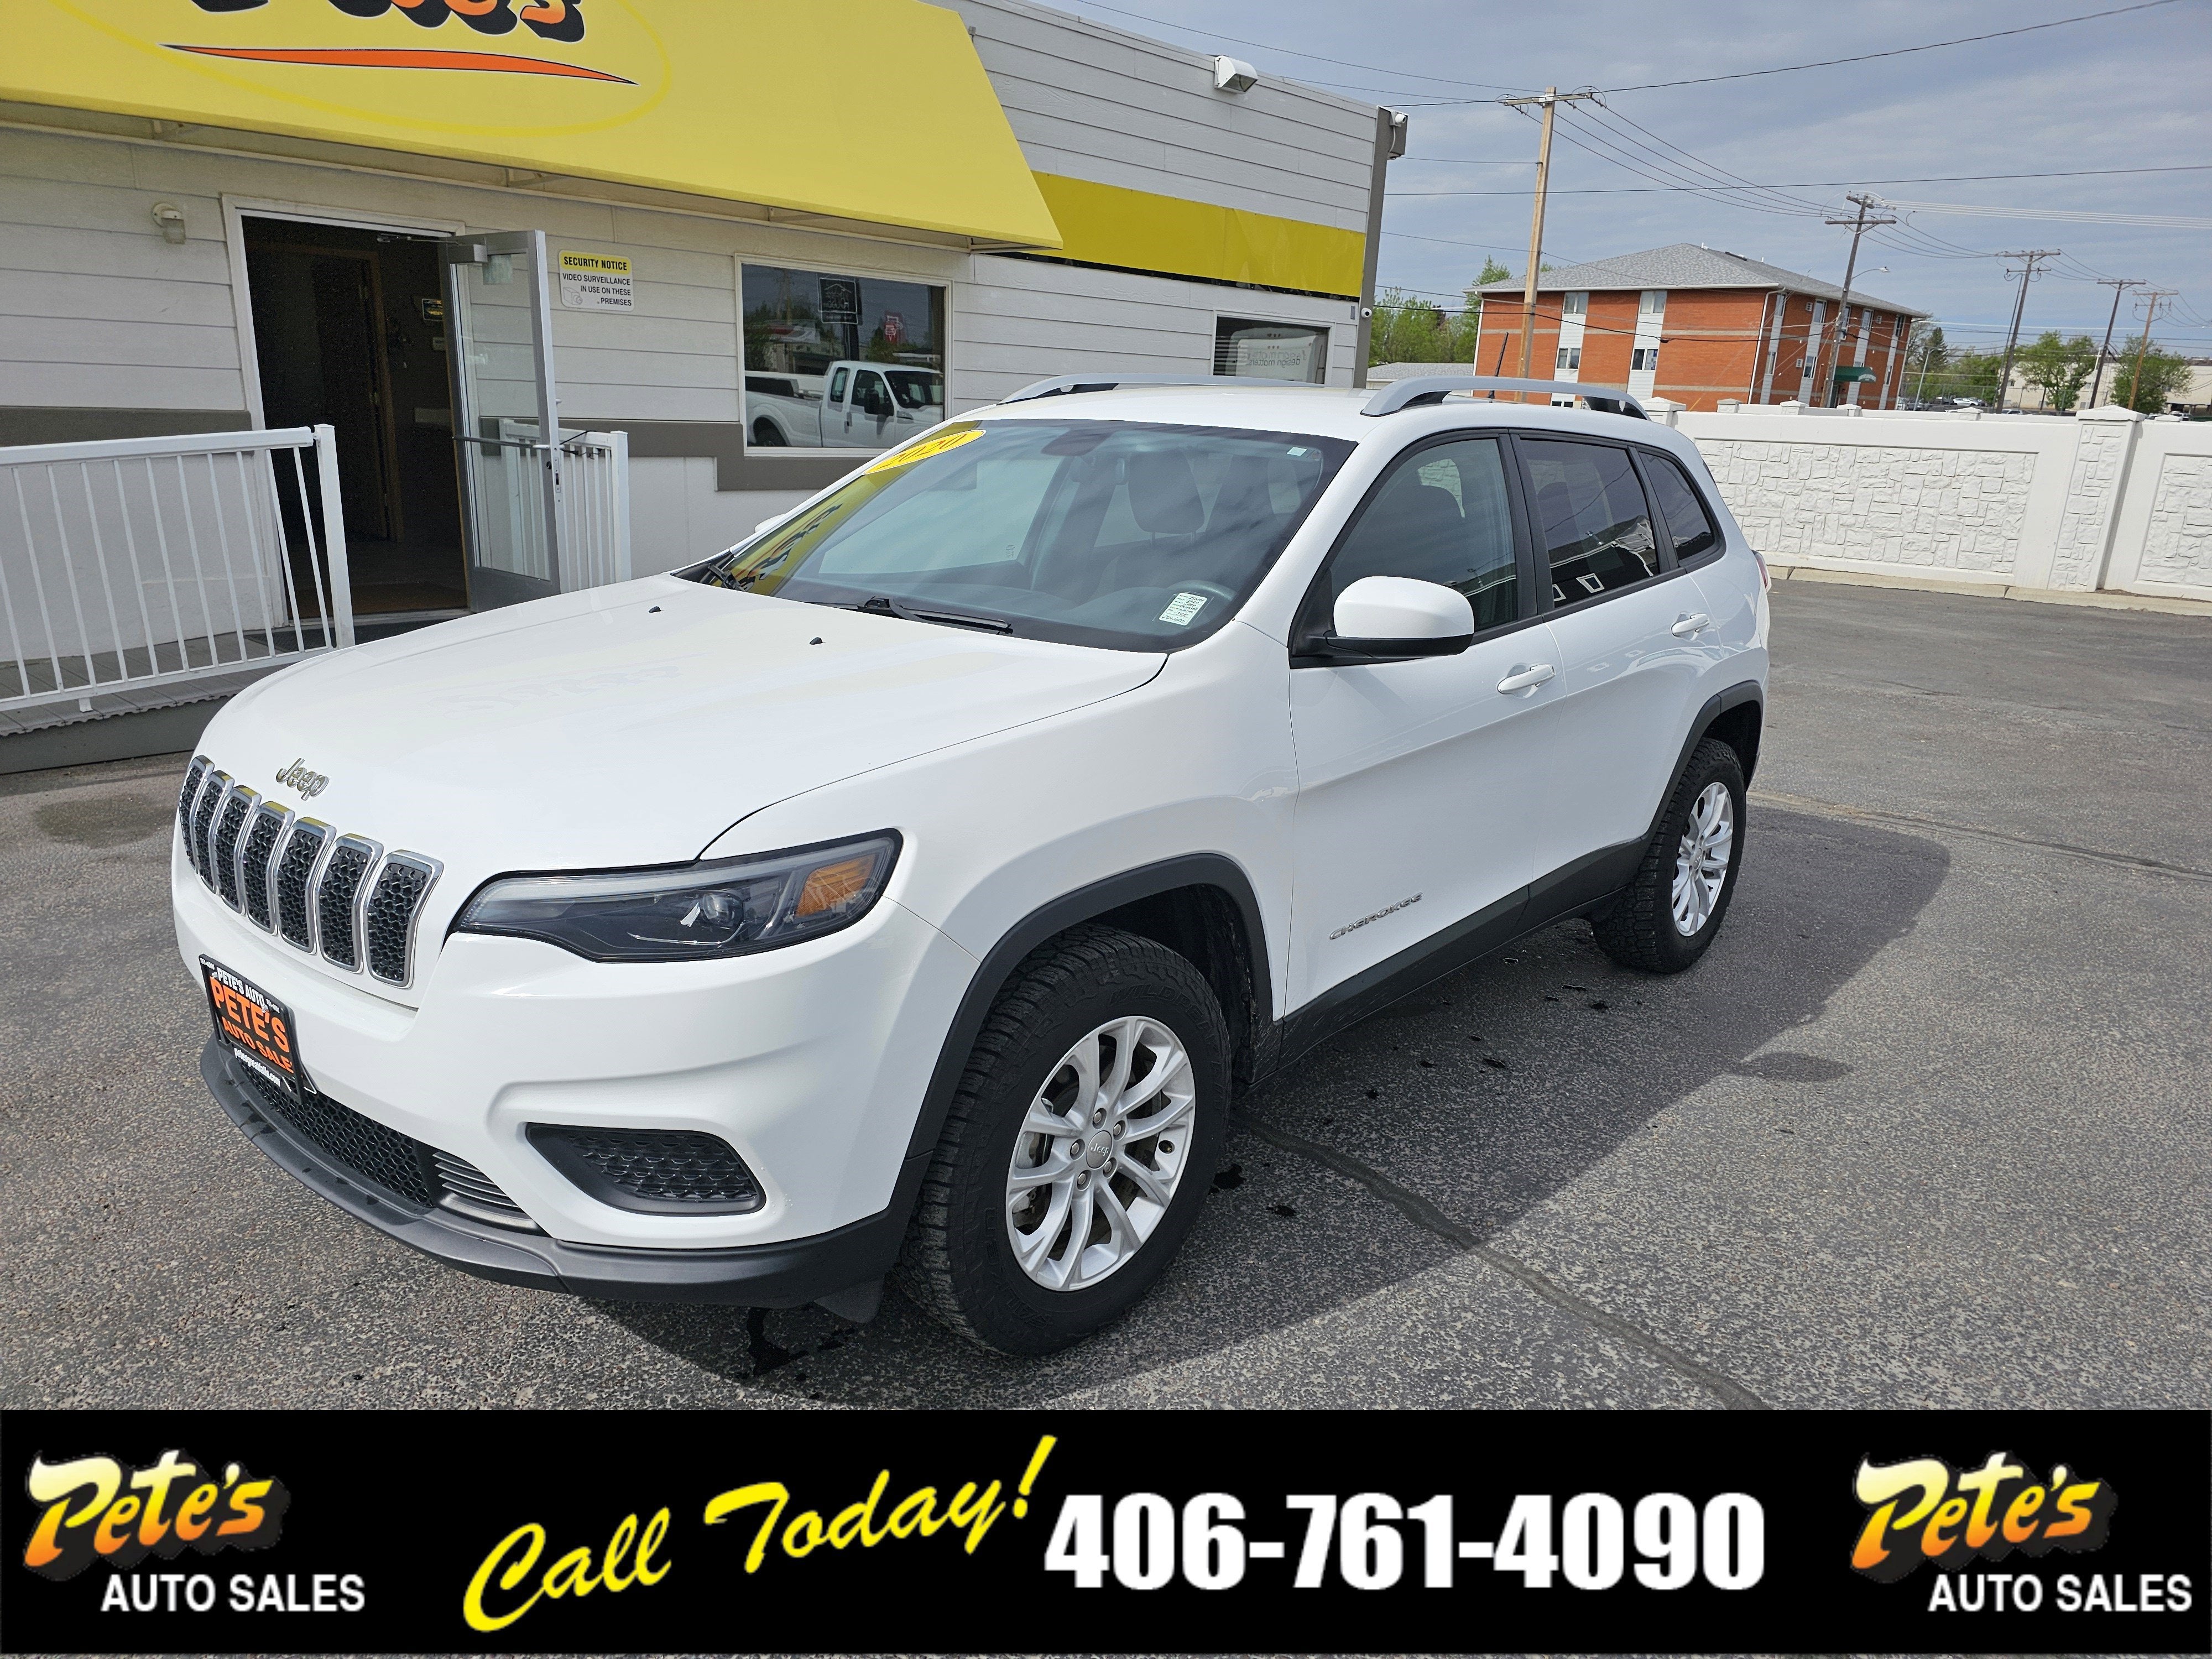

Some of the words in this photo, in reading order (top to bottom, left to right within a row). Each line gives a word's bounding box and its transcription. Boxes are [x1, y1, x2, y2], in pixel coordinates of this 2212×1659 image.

[564, 256, 598, 268] SECURITY
[601, 260, 627, 270] NOTICE
[562, 273, 582, 281] VIDEO
[583, 275, 630, 285] SURVEILLANCE
[601, 298, 632, 306] PREMISES
[877, 434, 967, 469] 2020
[276, 758, 330, 801] Jeep
[1329, 891, 1423, 940] CHEROKEE
[217, 967, 244, 995] PETE'S
[210, 975, 290, 1053] PETE'S
[222, 1016, 256, 1050] AUTO
[255, 1040, 294, 1074] SALE
[1091, 1143, 1109, 1157] Jeep
